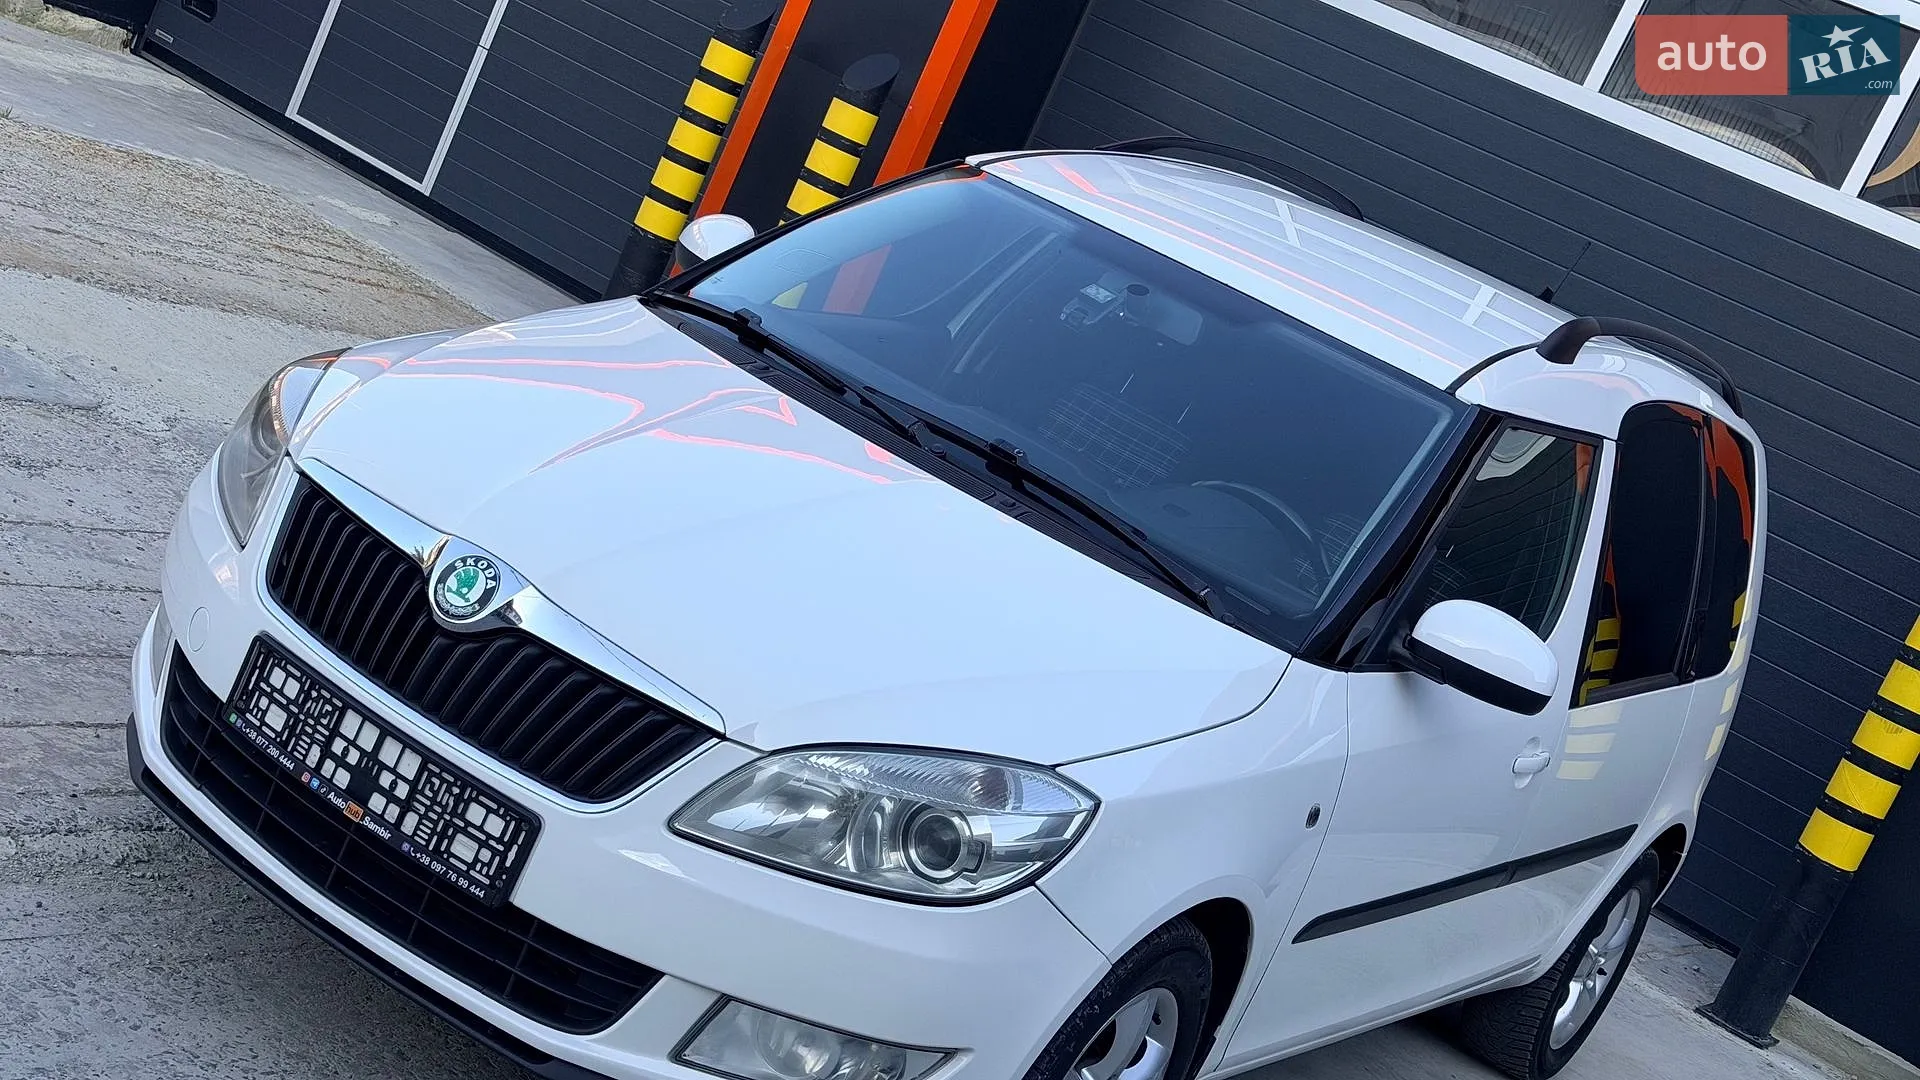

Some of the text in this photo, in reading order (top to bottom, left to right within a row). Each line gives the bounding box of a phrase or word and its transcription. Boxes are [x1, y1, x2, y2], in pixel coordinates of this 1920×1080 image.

[246, 727, 295, 771] +38 077 200 4444
[416, 852, 486, 899] +38 097 76 99 444
